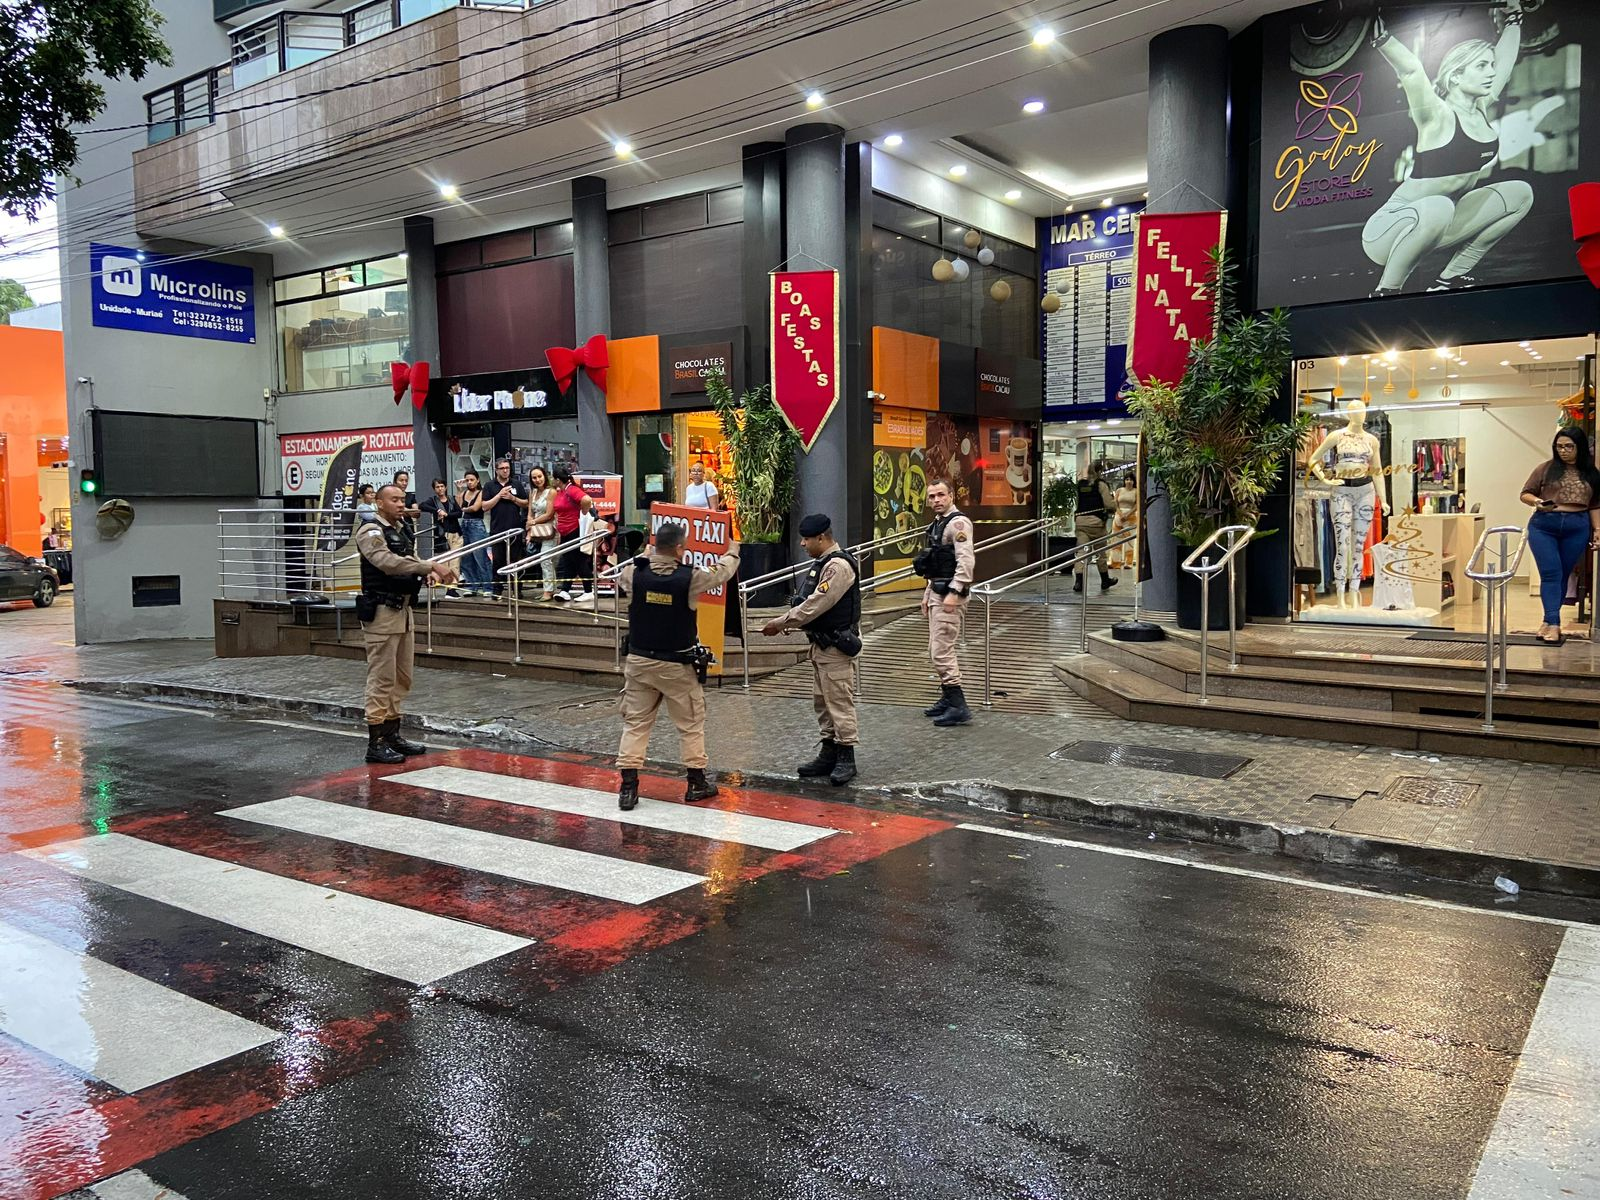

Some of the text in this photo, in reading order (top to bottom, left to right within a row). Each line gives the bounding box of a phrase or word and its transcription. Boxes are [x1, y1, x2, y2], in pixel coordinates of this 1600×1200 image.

[1300, 175, 1351, 194] STORE
[1296, 187, 1374, 207] MODA FITNESS
[1051, 221, 1097, 244] MAR
[1084, 250, 1116, 261] TÉRREO
[1147, 229, 1208, 300] FELIZ
[150, 273, 246, 303] Microlins
[159, 293, 222, 308] Profissionalizando
[781, 281, 821, 330] BOAS
[100, 303, 131, 315] Unidade
[136, 308, 163, 318] Muriaé
[781, 313, 828, 386] FESTAS
[675, 357, 725, 369] CHOCOLATES
[1300, 360, 1315, 370] 03
[675, 370, 698, 380] BRASIL
[980, 373, 1010, 385] CHOCOLATES
[285, 434, 368, 453] ESTACIONAMO
[361, 452, 407, 464] NCIONAMENTO:
[290, 467, 298, 484] E
[332, 488, 343, 520] Lder
[693, 515, 725, 544] TÁXI
